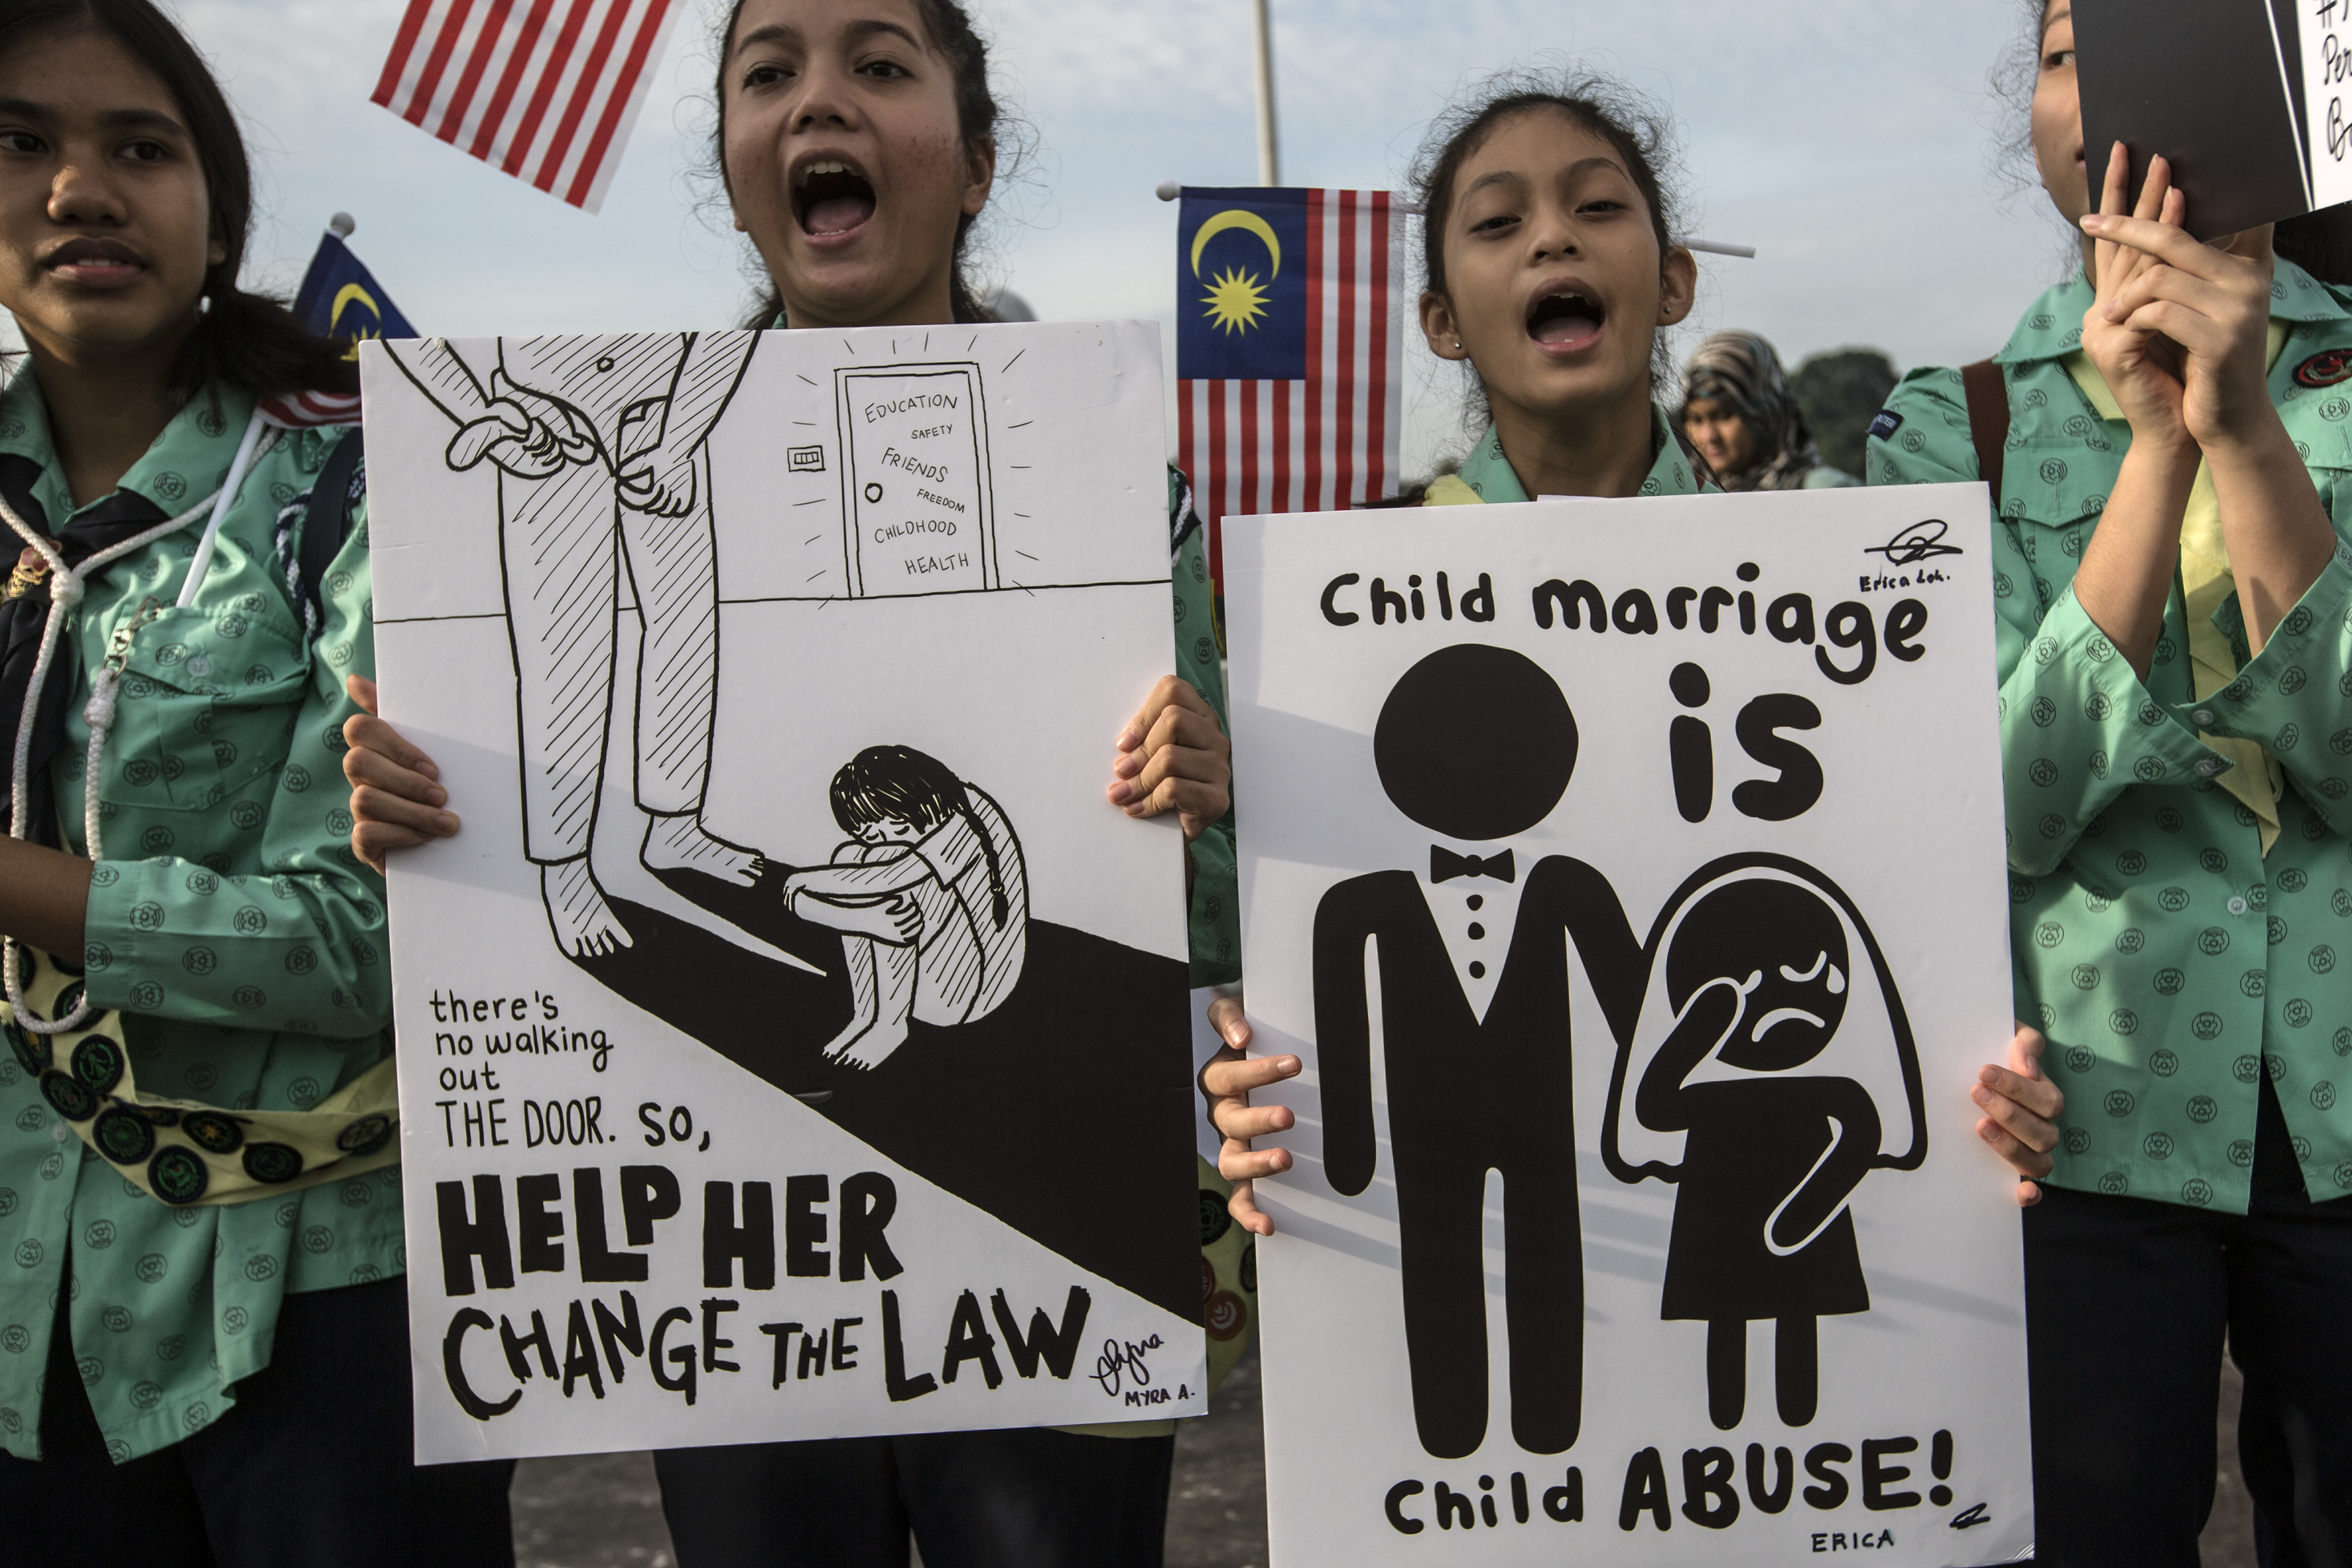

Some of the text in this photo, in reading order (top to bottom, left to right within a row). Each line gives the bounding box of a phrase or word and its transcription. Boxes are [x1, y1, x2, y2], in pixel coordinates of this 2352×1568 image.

[865, 394, 957, 423] EDUCATION
[911, 423, 953, 439] SAFETY
[881, 447, 948, 483] FRIENDS
[917, 488, 964, 513] FREEDOM
[874, 520, 957, 543] CHILDHOOD
[904, 552, 969, 575] HEALTH
[1859, 571, 1910, 593] Erica
[1321, 561, 1929, 686] Child marriage
[1669, 661, 1824, 824] is
[429, 989, 559, 1022] there's
[436, 1024, 614, 1073] no walking
[439, 1061, 500, 1091] out
[435, 1096, 711, 1152] THE DOOR. SO,
[435, 1164, 904, 1298] HELP HER
[443, 1285, 1092, 1421] CHANGE THE LAW
[1125, 1383, 1196, 1407] MYRA A.
[1385, 1428, 1954, 1536] Child ABUSE!
[1811, 1529, 1895, 1553] ERICA
